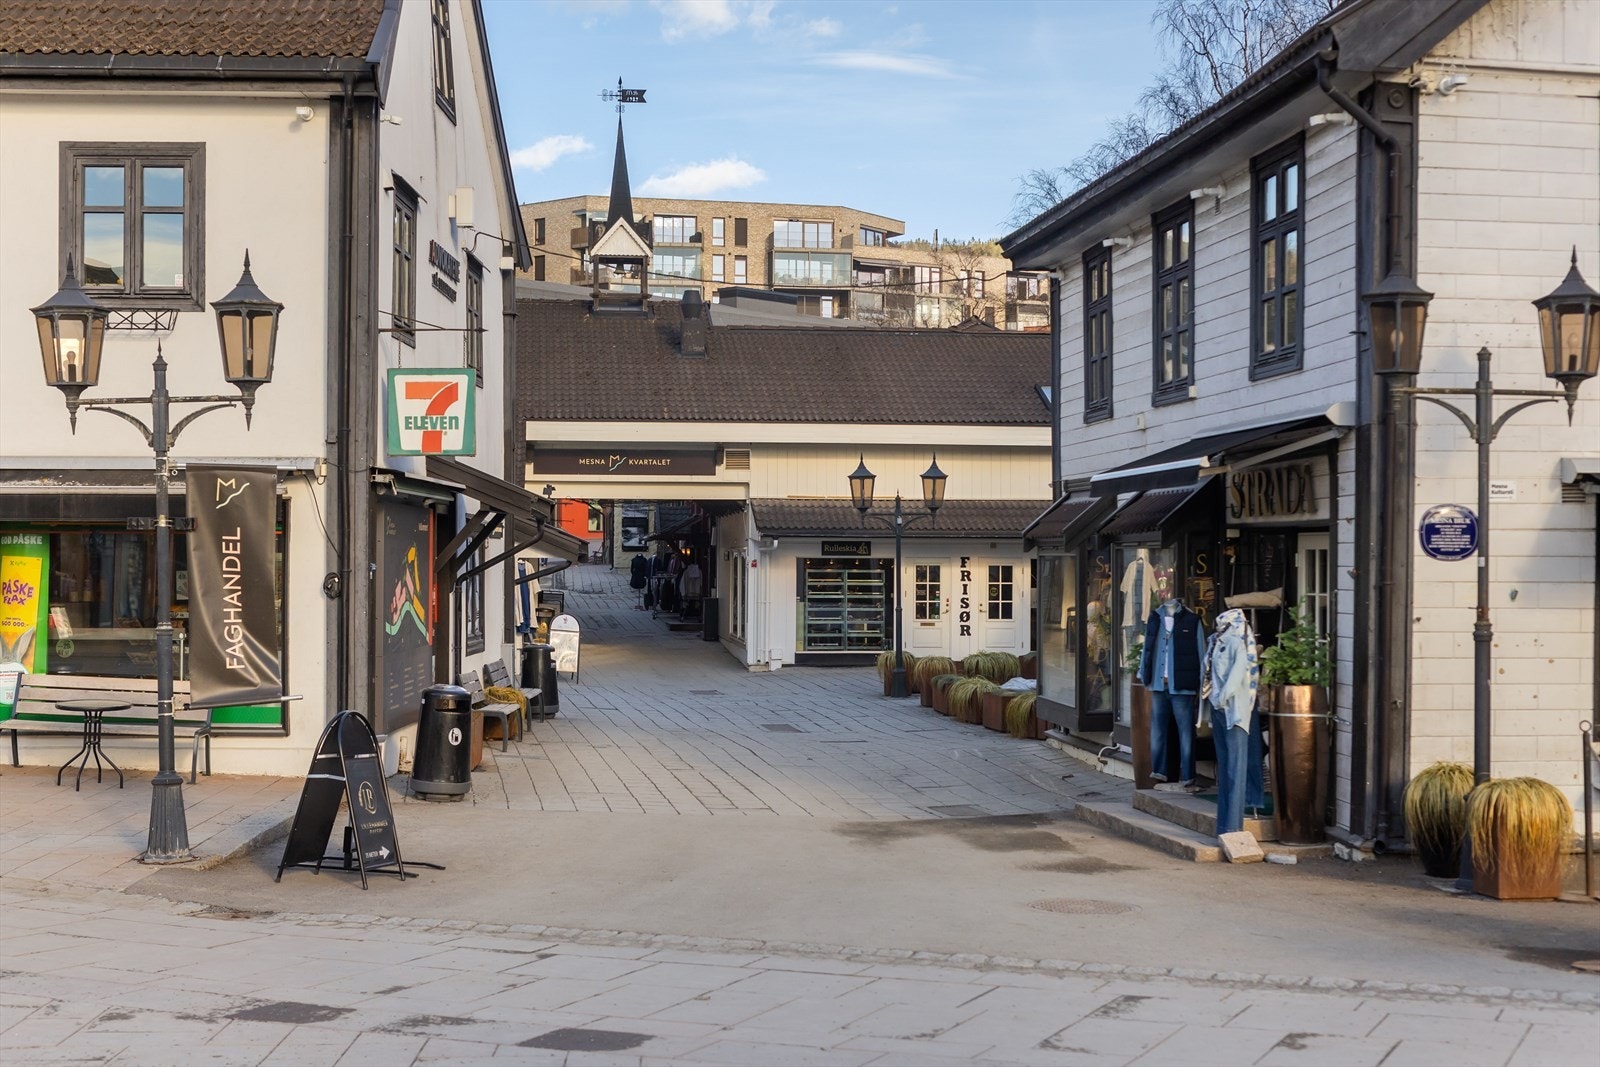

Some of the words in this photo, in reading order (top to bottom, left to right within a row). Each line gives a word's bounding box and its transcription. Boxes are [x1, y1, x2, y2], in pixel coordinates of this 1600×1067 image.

[405, 381, 458, 453] 7
[1230, 464, 1318, 519] STRADA
[12, 533, 43, 545] PÅSKE
[1, 579, 34, 597] PÅSKE
[3, 595, 26, 605] FLAX
[222, 526, 246, 669] FAGHANDEL
[959, 556, 972, 636] FRISØR
